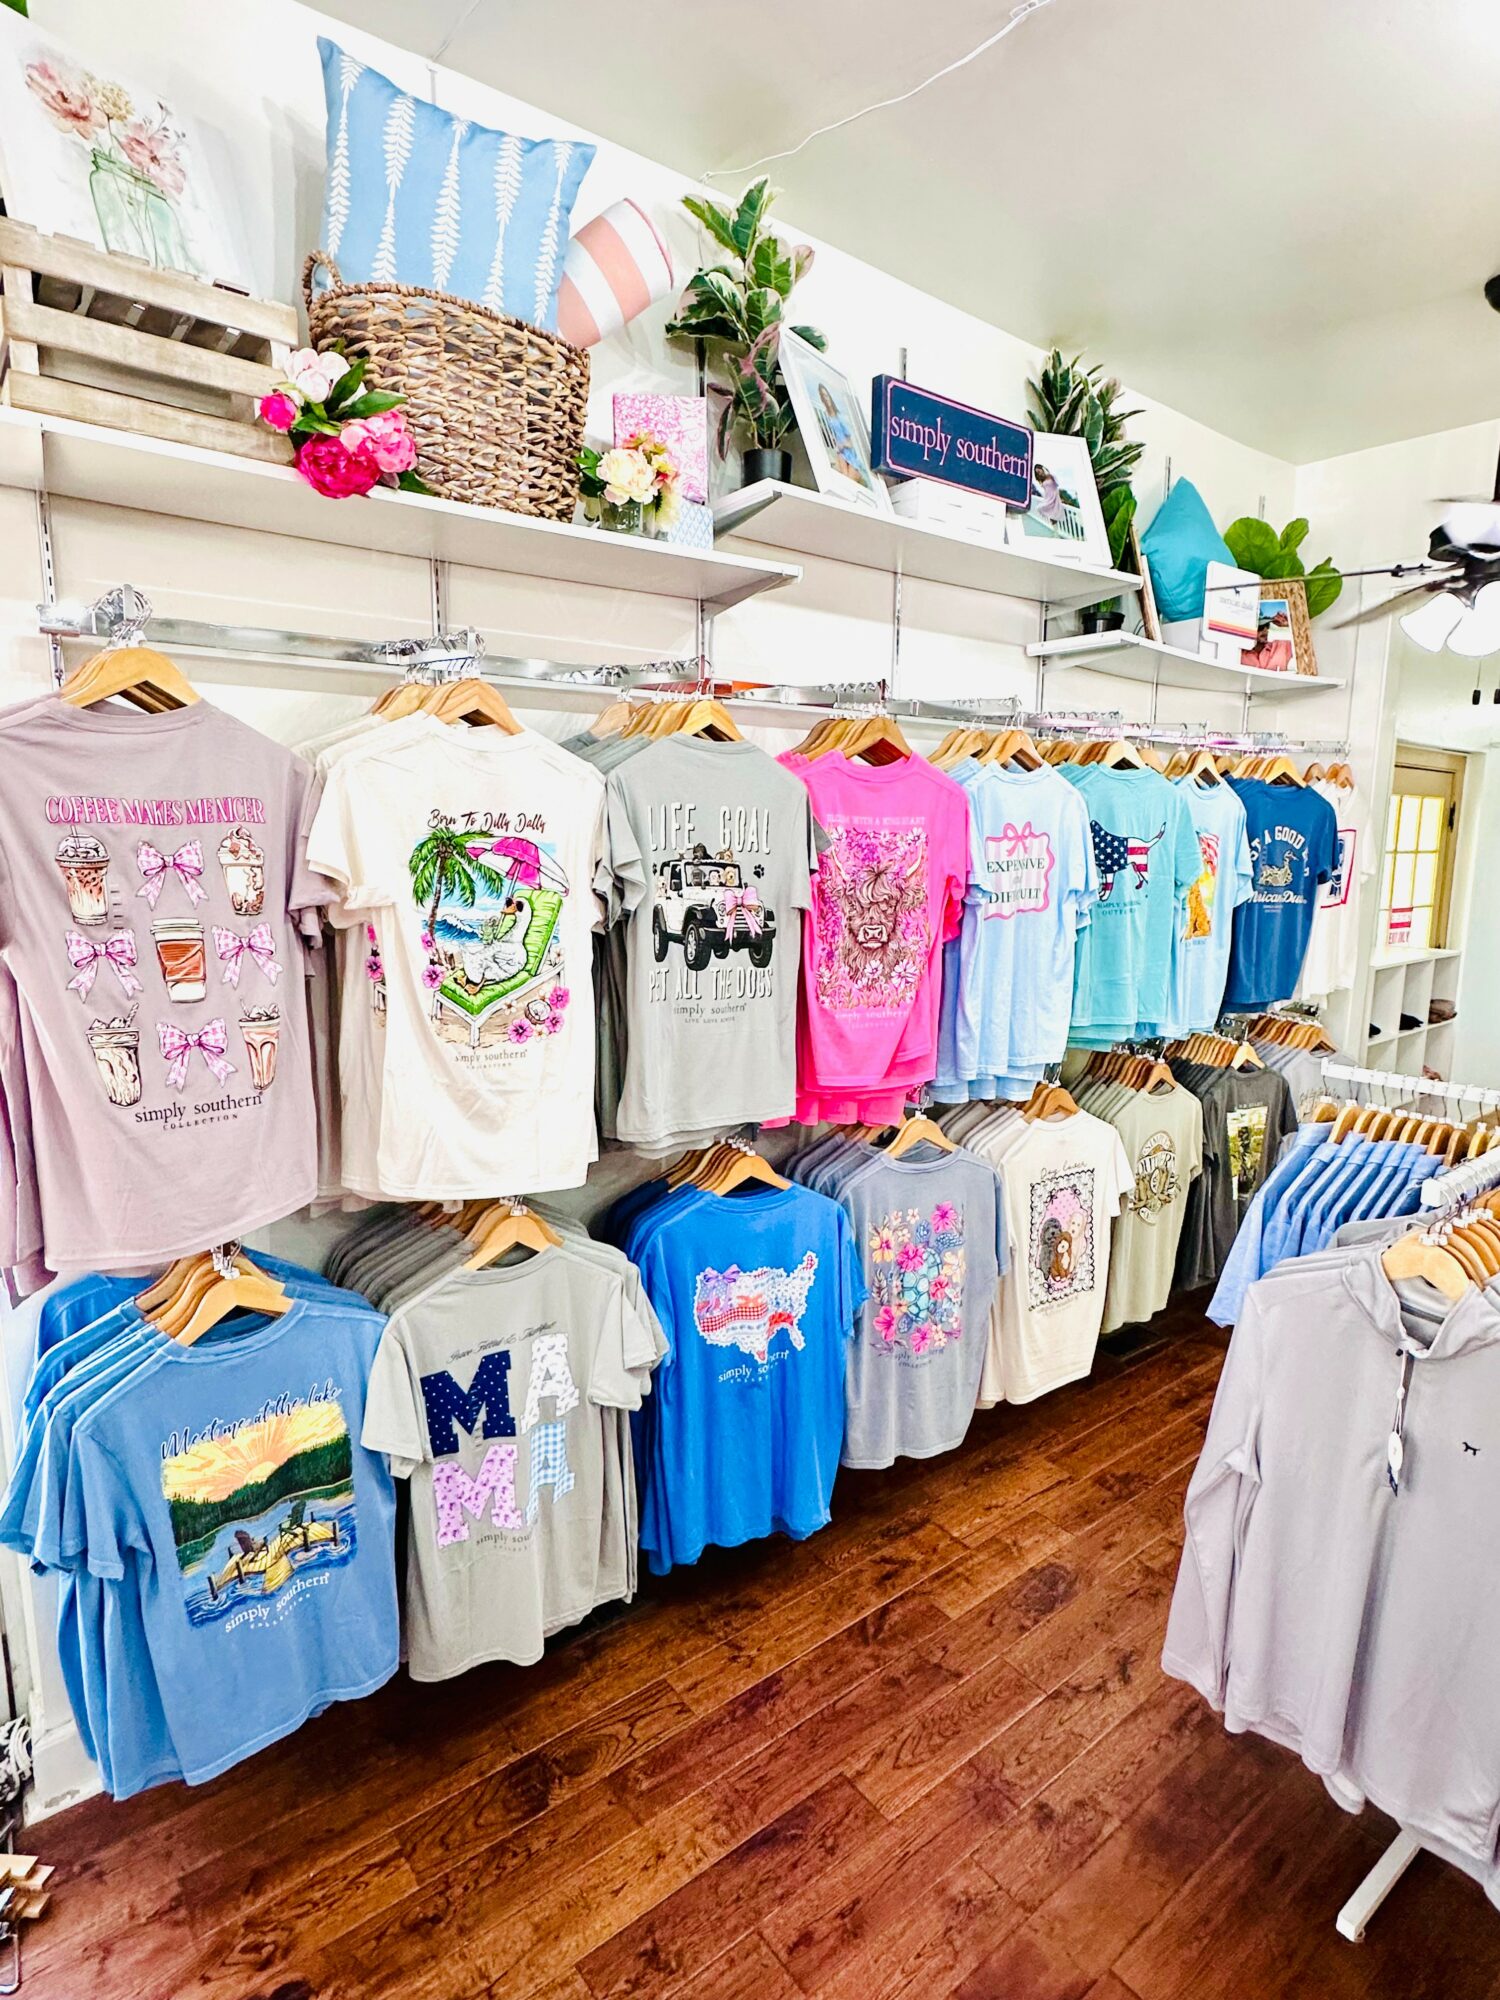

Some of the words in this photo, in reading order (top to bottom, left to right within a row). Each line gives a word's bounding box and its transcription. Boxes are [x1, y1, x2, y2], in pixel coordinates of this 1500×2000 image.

[890, 406, 951, 465] simply
[956, 436, 1028, 478] southern
[45, 796, 121, 824] COFFEE
[121, 798, 183, 825] MAKES
[185, 798, 213, 824] ME
[215, 797, 265, 824] NICER
[427, 809, 458, 828] Born
[461, 811, 479, 828] To
[480, 812, 510, 832] Dilly
[514, 813, 547, 833] Dally
[648, 802, 697, 851] LIFE
[719, 805, 770, 855] GOAL
[1264, 829, 1272, 845] A
[1275, 826, 1305, 849] GOOD
[989, 888, 1041, 904] DIFCULT
[649, 967, 669, 1003] PET
[675, 966, 702, 1000] ALL
[710, 967, 733, 1000] THE
[736, 966, 773, 999] DOGS
[674, 1003, 705, 1018] simply
[135, 1102, 186, 1124] simply
[194, 1093, 262, 1116] southern
[163, 1114, 239, 1131] COLLECTION
[718, 1364, 752, 1382] simply
[758, 1350, 788, 1374] soern
[161, 1417, 222, 1460] Meet
[223, 1419, 249, 1440] me
[254, 1400, 273, 1424] at
[275, 1391, 304, 1417] the
[476, 1531, 507, 1546] simply
[225, 1605, 270, 1633] simply
[276, 1574, 329, 1611] southern
